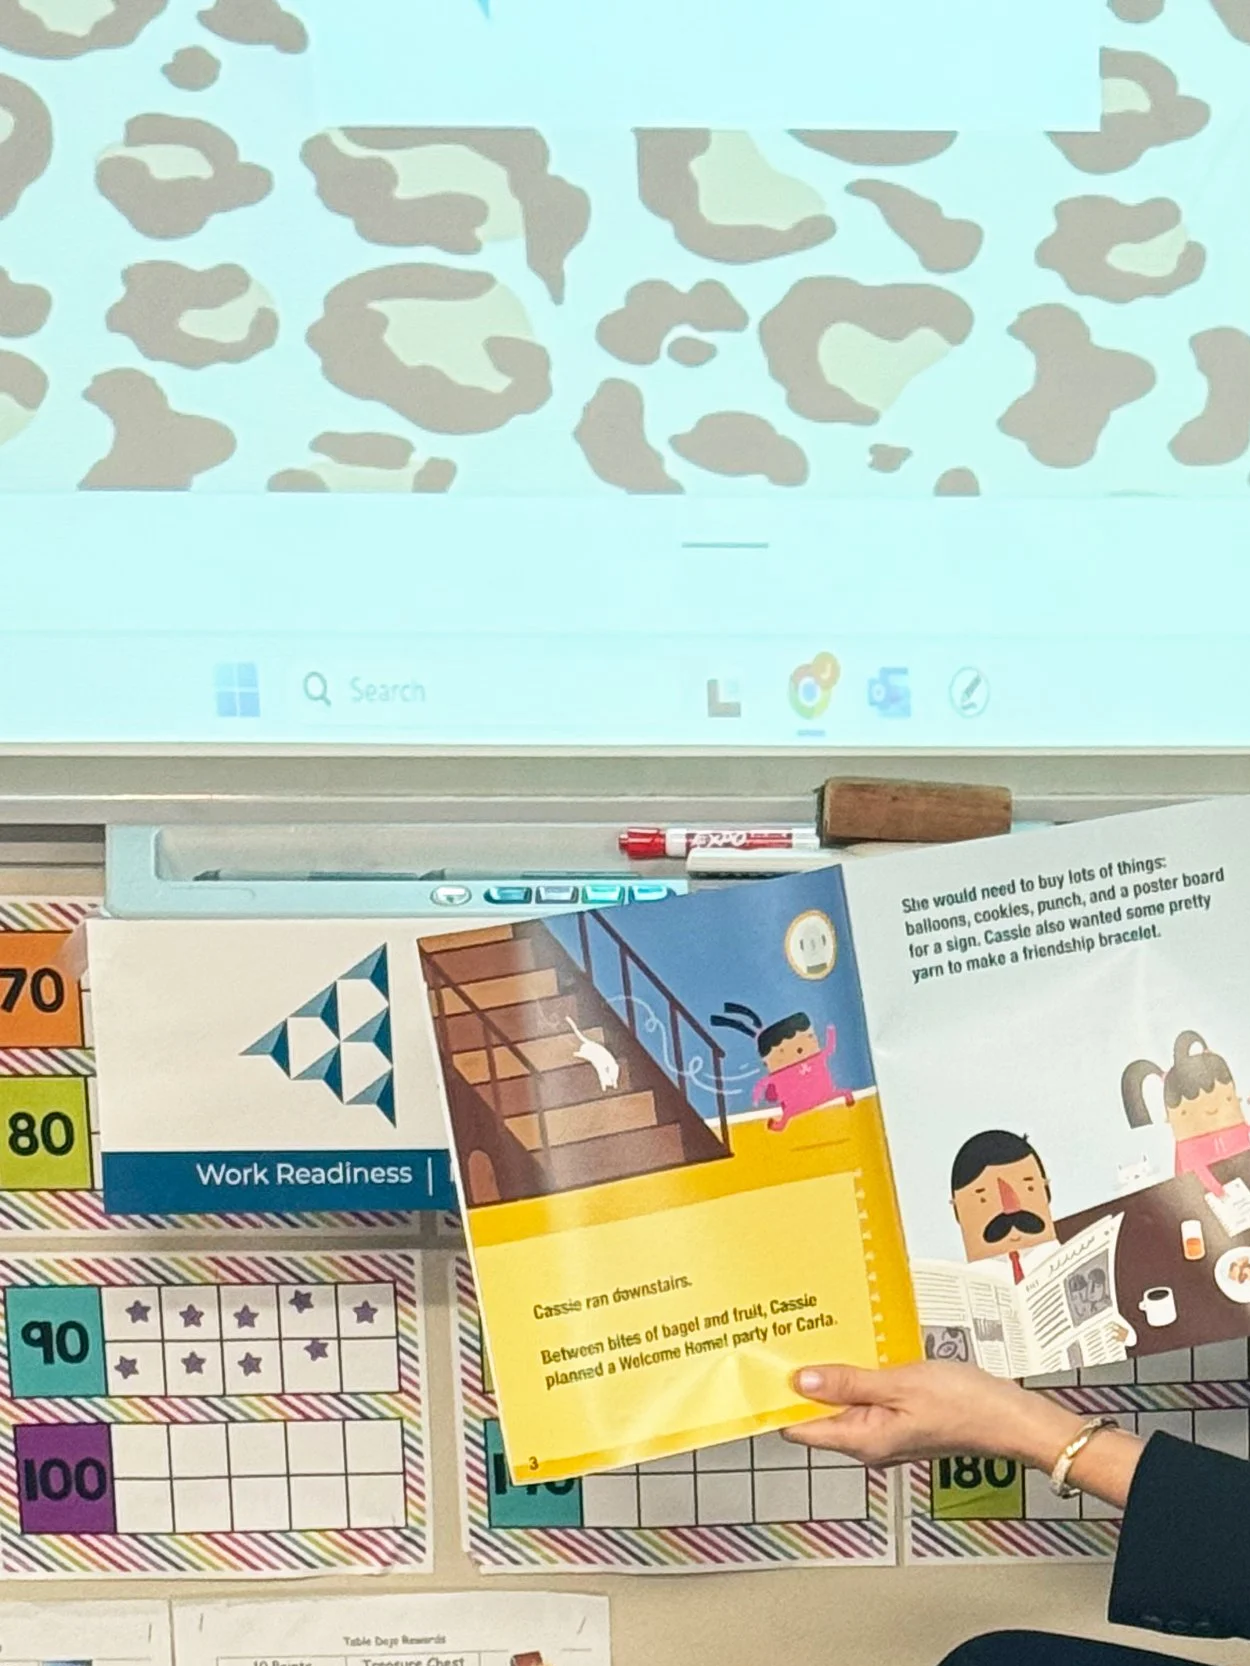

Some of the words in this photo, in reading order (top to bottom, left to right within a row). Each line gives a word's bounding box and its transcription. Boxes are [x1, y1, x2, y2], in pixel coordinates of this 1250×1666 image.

[349, 676, 426, 703] Search
[690, 831, 748, 849] EXPO
[901, 897, 930, 914] She
[932, 885, 978, 909] would
[980, 878, 1017, 901] need
[1019, 877, 1035, 893] to
[1037, 873, 1065, 890] buy
[1067, 867, 1096, 885] lots
[1098, 862, 1114, 880] of
[1116, 856, 1167, 877] things:
[904, 914, 972, 937] balloons,
[973, 902, 1035, 925] cookies,
[1036, 891, 1087, 917] punch,
[1089, 884, 1117, 904] and
[1119, 885, 1130, 899] a
[1132, 876, 1179, 900] poster
[1181, 866, 1225, 888] board
[908, 943, 930, 959] for
[933, 941, 943, 955] a
[945, 935, 982, 954] sign.
[983, 923, 1032, 946] Cassie
[1035, 919, 1066, 937] also
[1068, 906, 1123, 930] wanted
[1125, 902, 1165, 921] some
[1168, 893, 1212, 917] pretty
[911, 964, 945, 985] yarn
[947, 959, 963, 975] to
[965, 951, 1007, 972] make
[1009, 950, 1020, 964] a
[1022, 935, 1096, 961] friendship
[1097, 923, 1162, 948] bracelet.
[8, 1111, 75, 1157] 80
[196, 1162, 270, 1185] Work
[276, 1161, 413, 1185] Readiness
[532, 1298, 583, 1320] Cassie
[585, 1293, 610, 1310] ran
[611, 1275, 693, 1304] downstairs.
[21, 1321, 90, 1365] 90
[539, 1341, 605, 1366] Between
[606, 1332, 643, 1352] bites
[644, 1325, 659, 1343] of
[661, 1315, 701, 1339] bagel
[703, 1309, 730, 1330] and
[732, 1302, 768, 1323] fruit,
[769, 1293, 818, 1315] Cassie
[544, 1361, 605, 1392] planned
[607, 1361, 617, 1375] a
[618, 1346, 682, 1372] Welcome
[683, 1332, 729, 1357] Home!
[731, 1325, 769, 1349] party
[771, 1321, 793, 1338] for
[795, 1312, 838, 1333] Carla.
[24, 1456, 107, 1502] 100
[528, 1456, 539, 1471] 3
[940, 1457, 1016, 1488] 180
[343, 1635, 372, 1647] Table
[401, 1634, 446, 1646] Rewards
